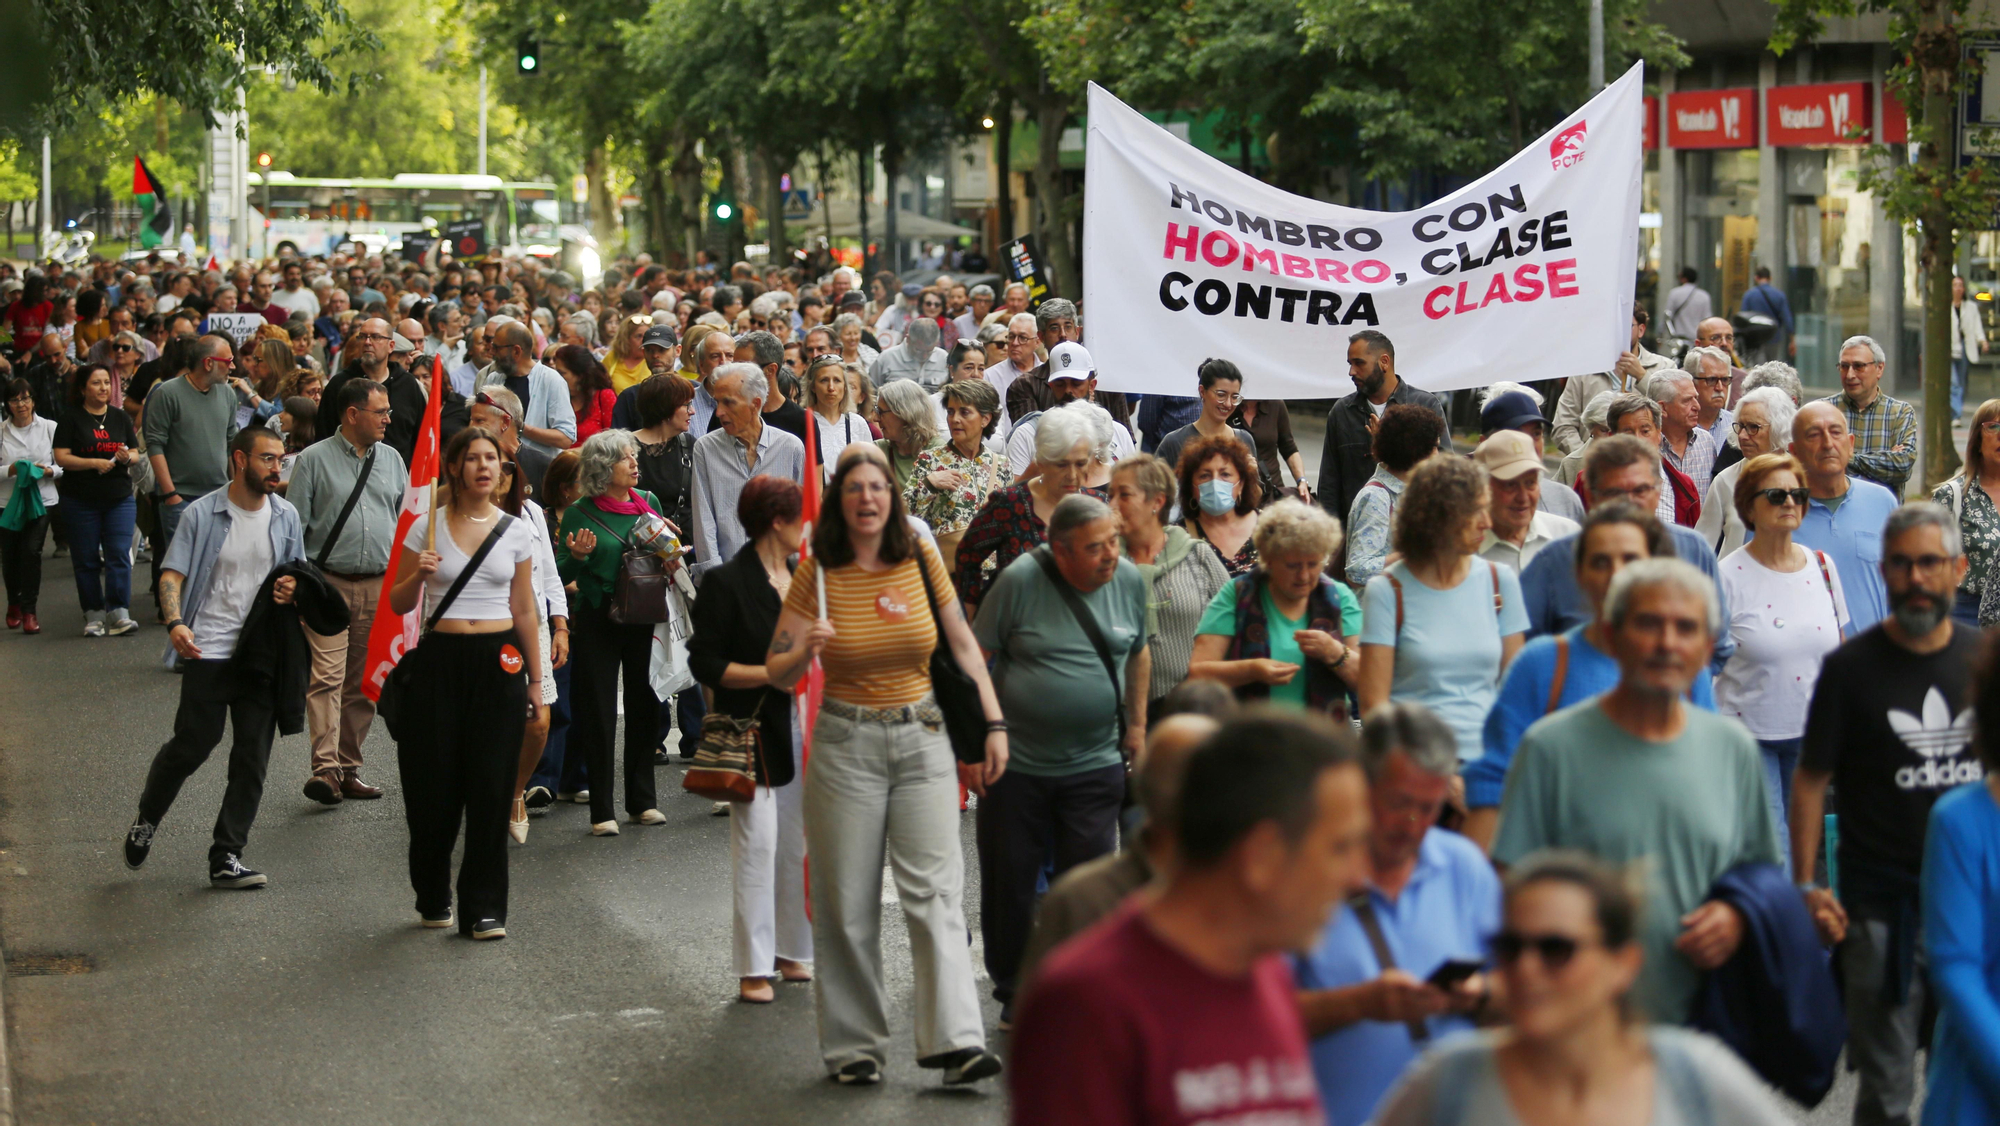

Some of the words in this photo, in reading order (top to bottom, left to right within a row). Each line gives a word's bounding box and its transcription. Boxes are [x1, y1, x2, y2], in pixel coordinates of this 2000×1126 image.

[1552, 151, 1586, 171] PCTE
[1169, 182, 1383, 252] HOMBRO
[1412, 184, 1526, 242] CON
[1163, 221, 1408, 286] HOMBRO,
[1421, 210, 1572, 276] CLASE
[1159, 271, 1380, 326] CONTRA
[1423, 258, 1579, 320] CLASE
[210, 316, 233, 331] NO
[237, 316, 246, 325] A
[93, 429, 110, 439] NO
[1894, 758, 1983, 788] adidas
